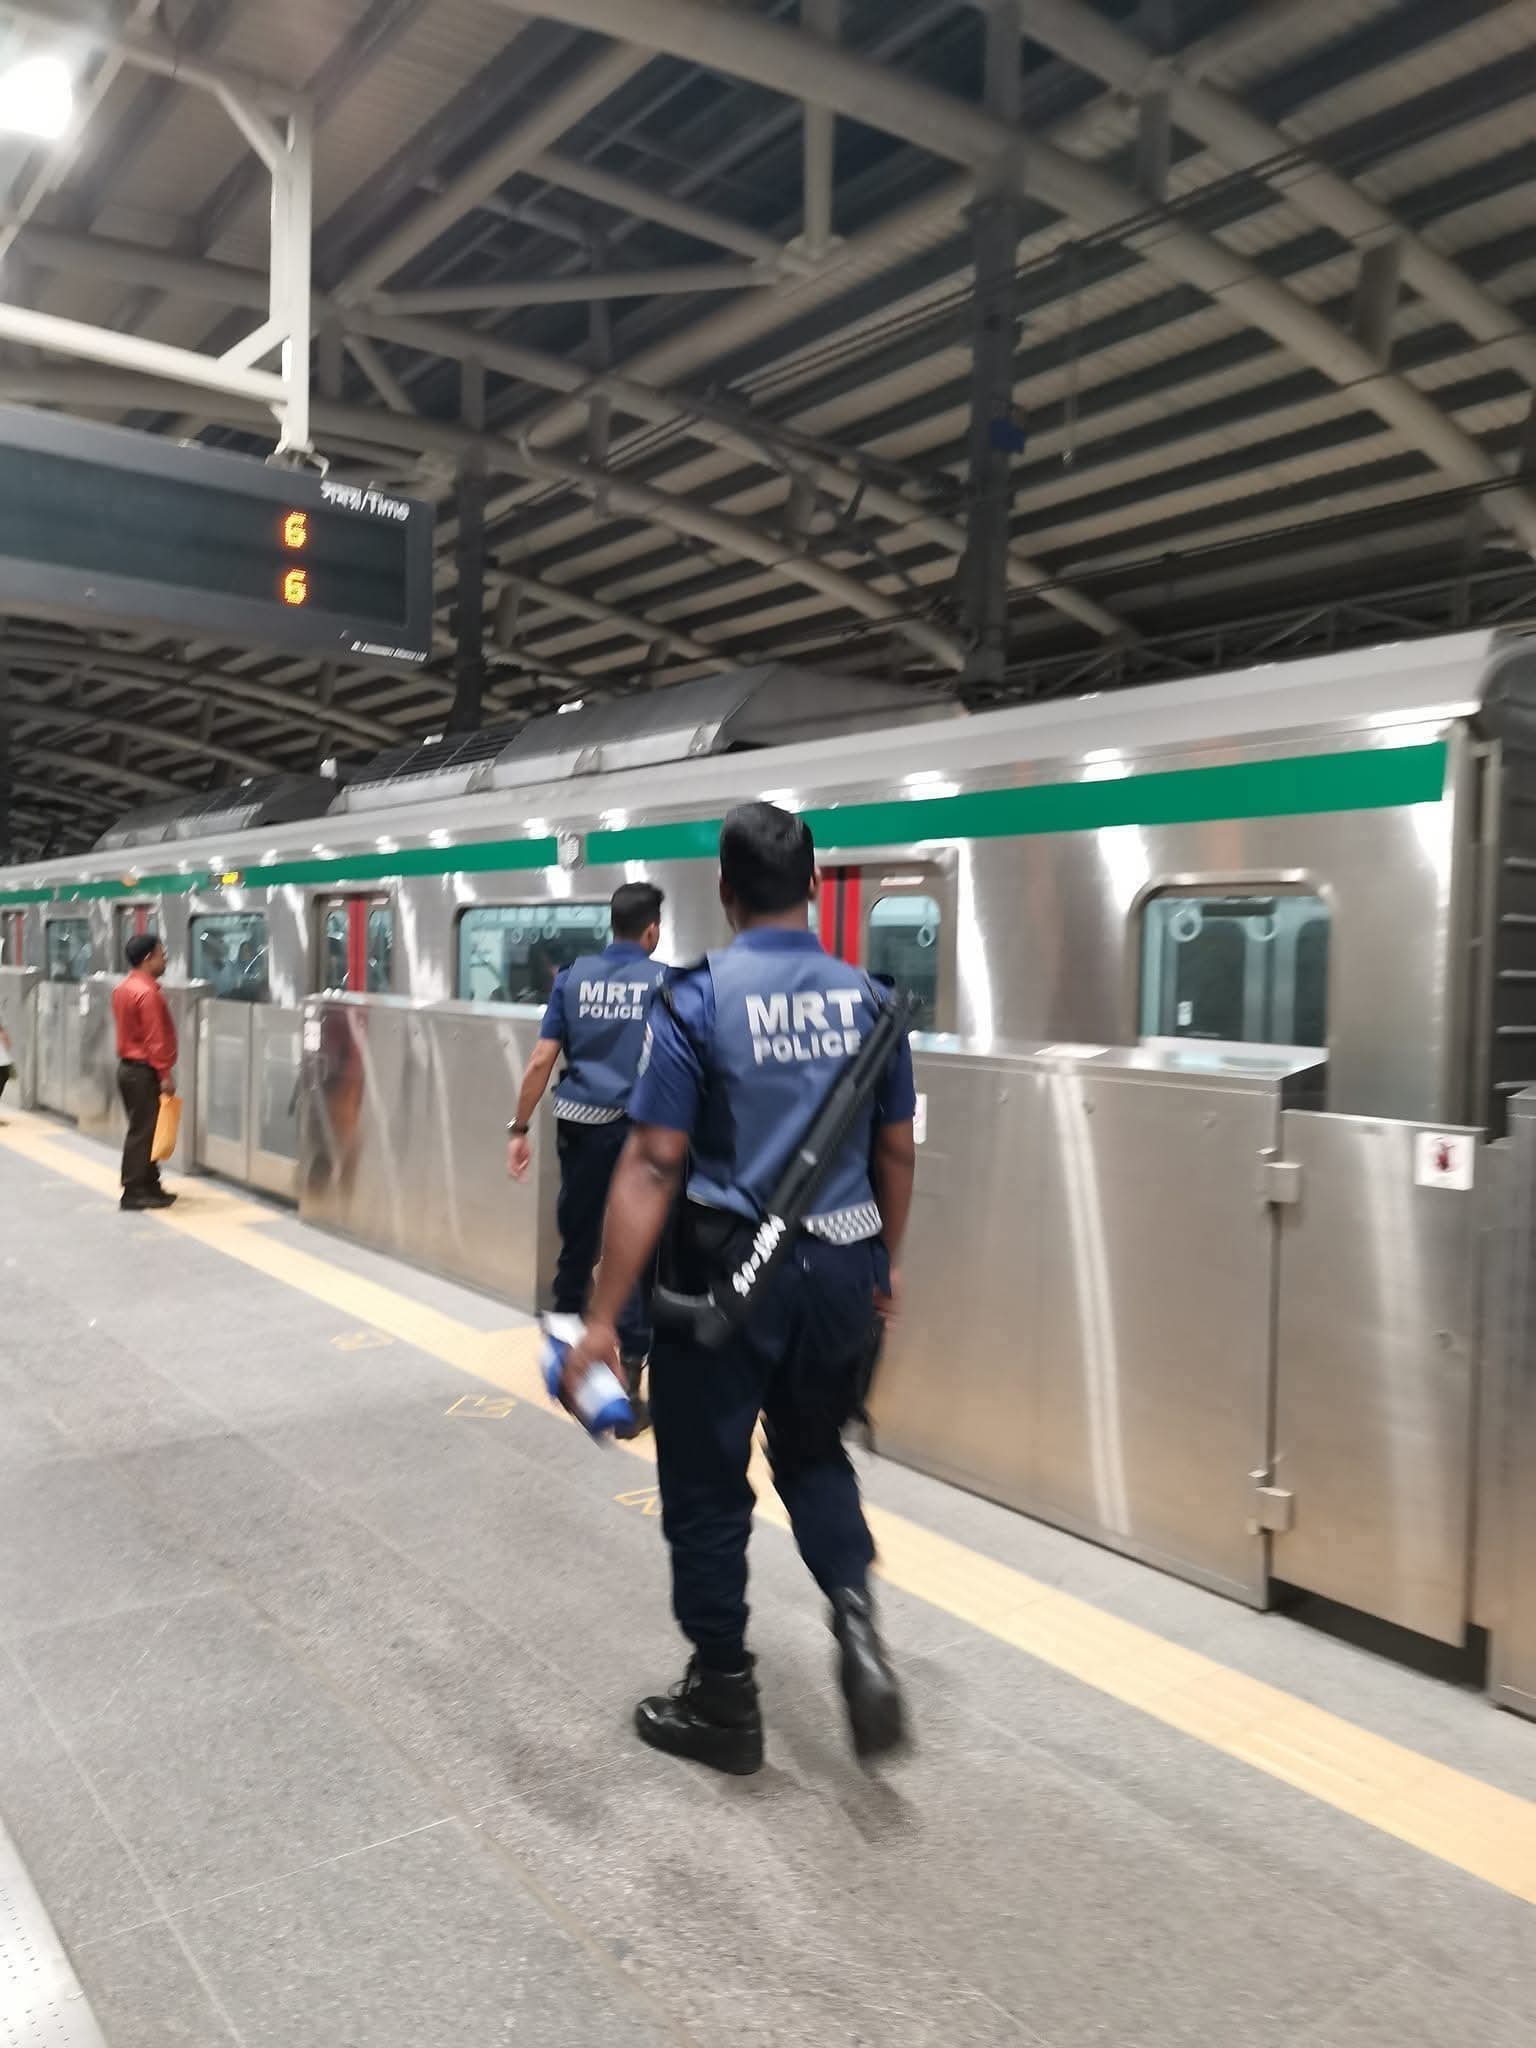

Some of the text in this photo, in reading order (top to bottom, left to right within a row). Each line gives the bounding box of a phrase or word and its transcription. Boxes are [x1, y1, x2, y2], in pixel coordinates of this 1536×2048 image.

[285, 511, 307, 548] 6
[285, 568, 307, 605] 6
[579, 981, 649, 1004] MRT
[579, 1003, 643, 1020] POLICE
[745, 989, 863, 1035] MRT
[752, 1028, 862, 1065] POLICE
